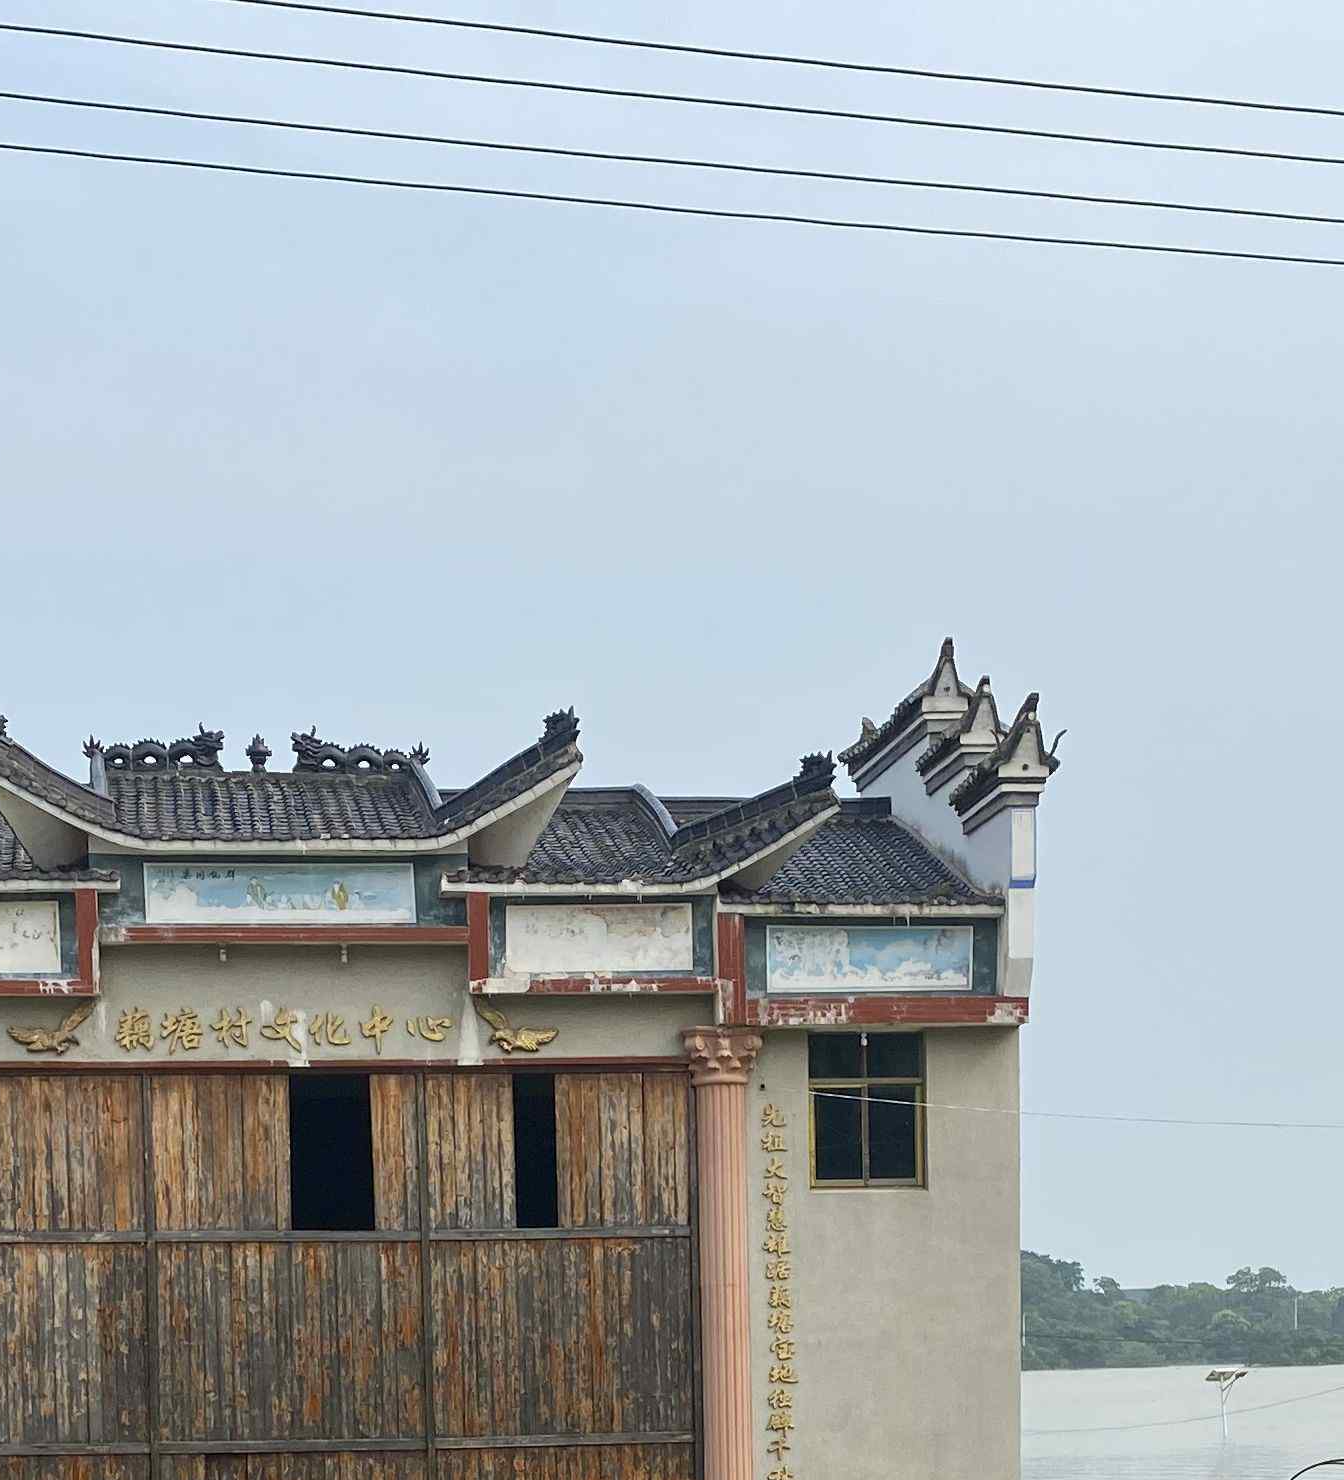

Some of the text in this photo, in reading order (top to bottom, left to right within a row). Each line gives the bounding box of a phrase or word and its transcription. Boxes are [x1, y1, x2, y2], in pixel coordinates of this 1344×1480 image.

[116, 1005, 454, 1055] 藕塘村文化中心
